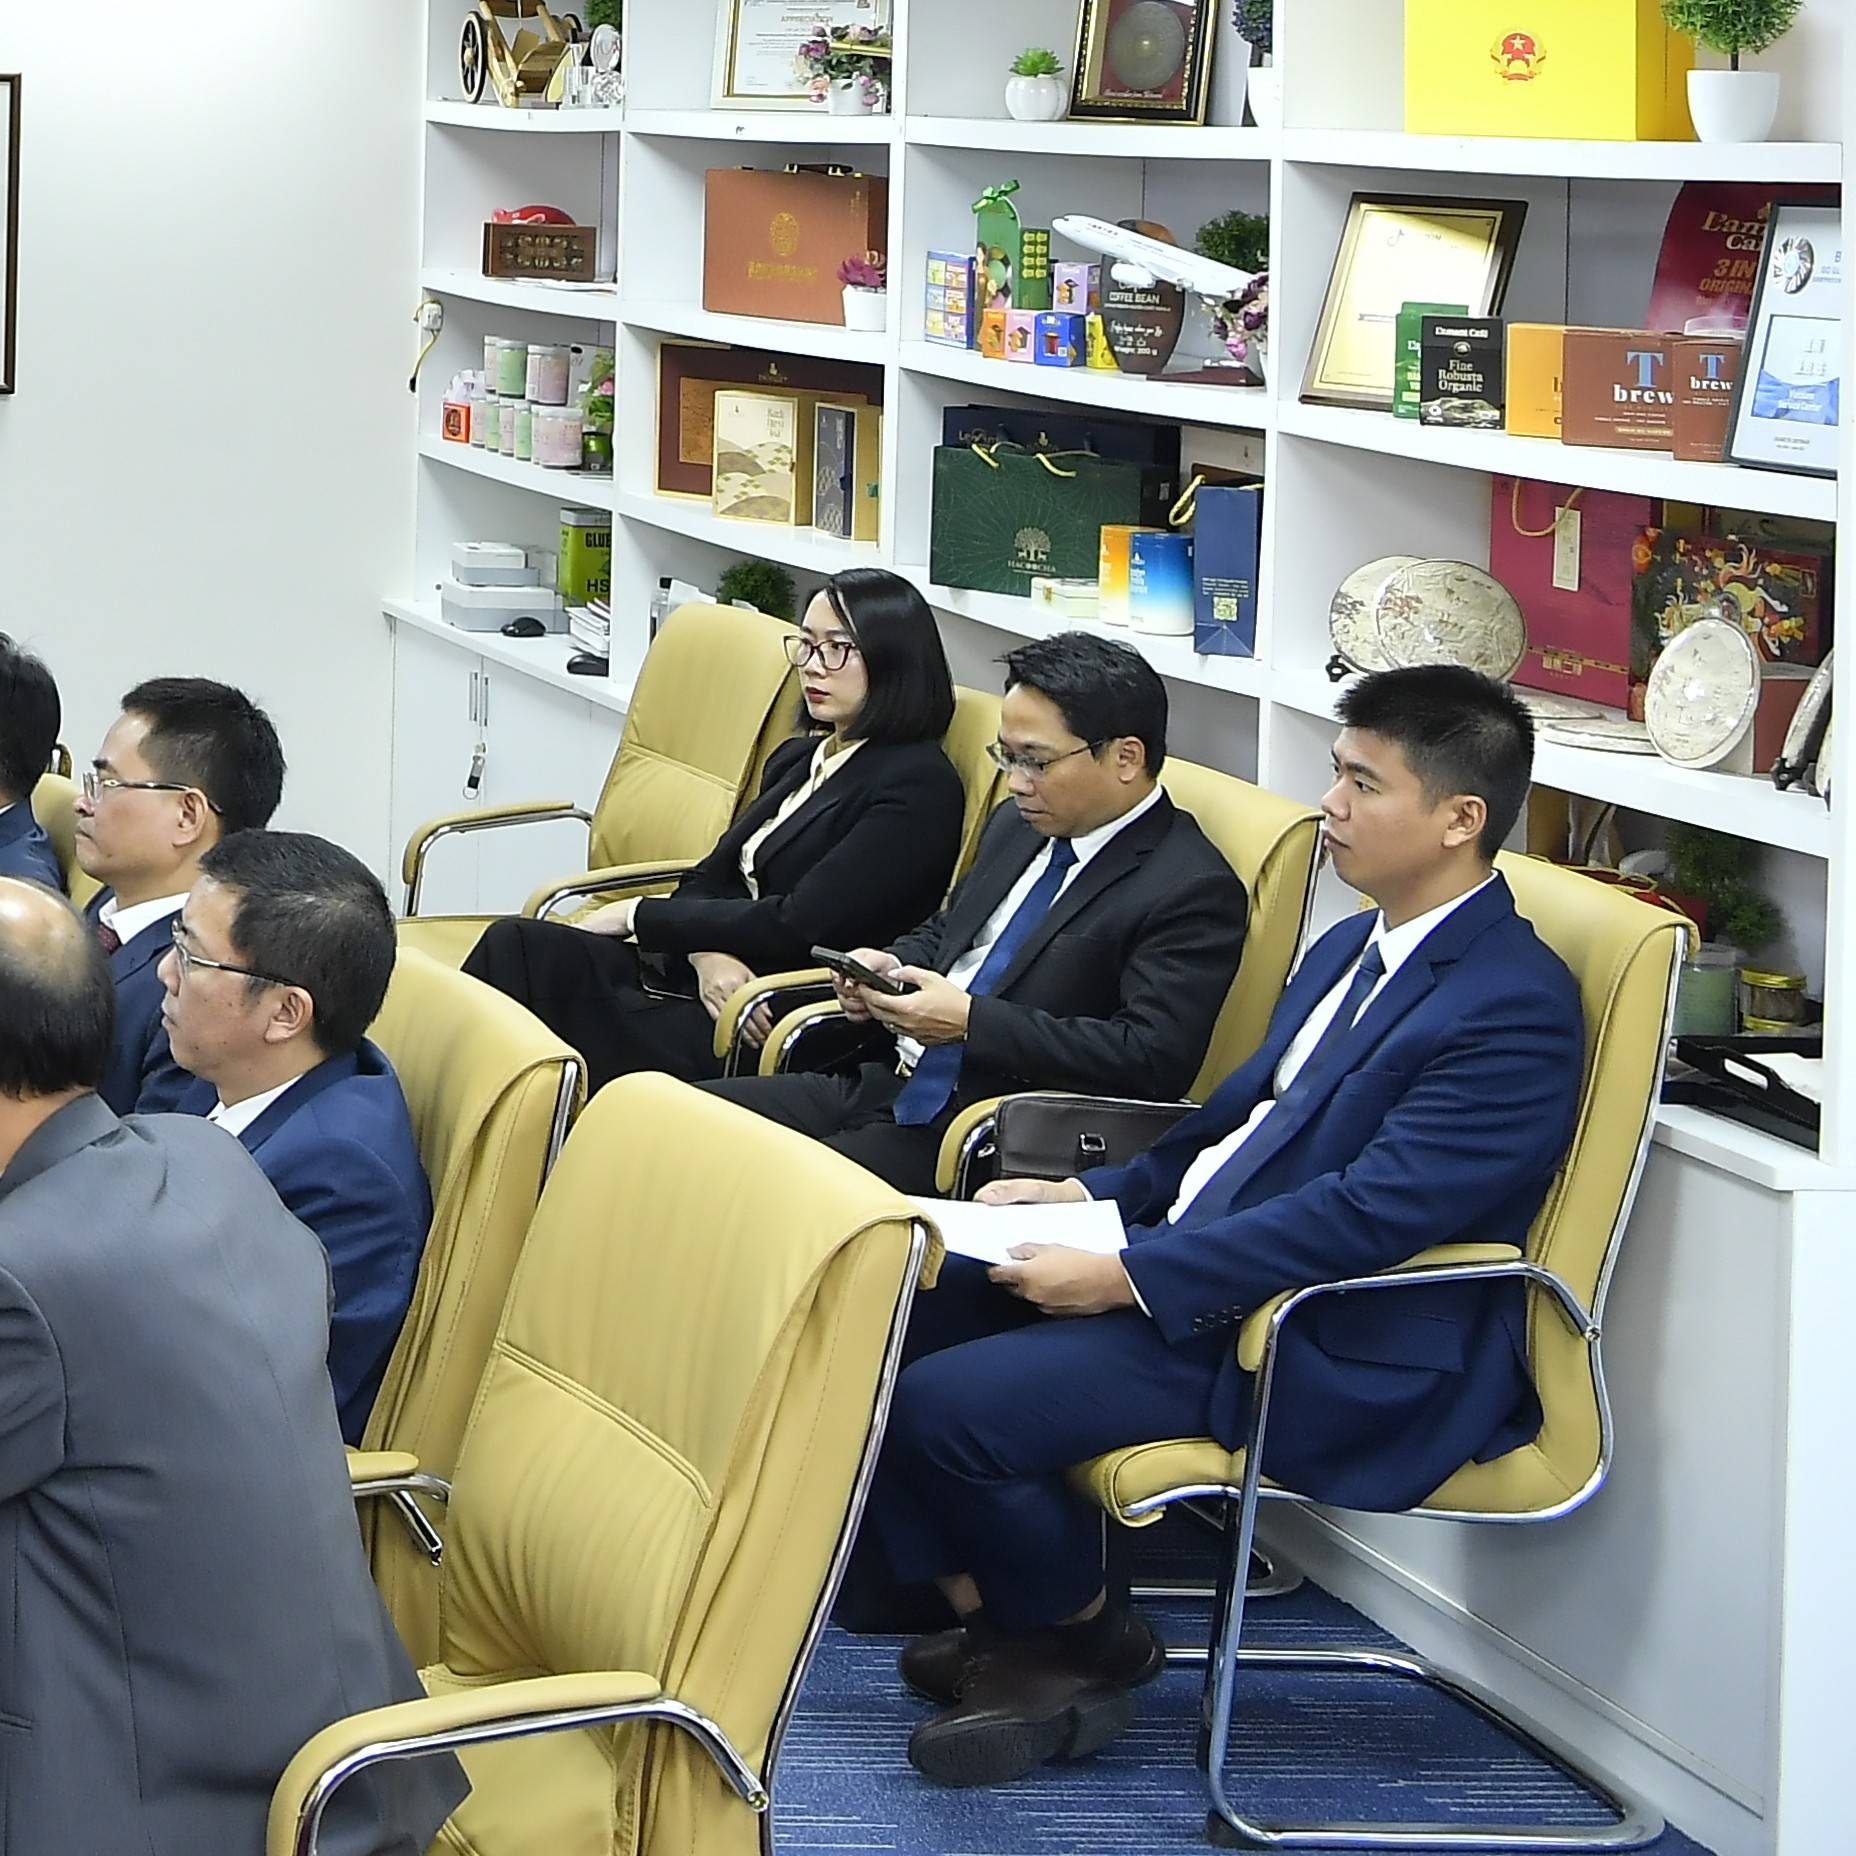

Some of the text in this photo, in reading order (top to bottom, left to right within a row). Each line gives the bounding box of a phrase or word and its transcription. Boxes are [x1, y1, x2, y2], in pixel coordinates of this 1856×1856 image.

[1135, 294, 1160, 304] BEAN
[1449, 359, 1473, 371] Fine
[1626, 351, 1664, 388] T
[1699, 354, 1725, 379] T
[1439, 369, 1484, 382] Robusta
[1438, 380, 1483, 393] Organic
[1690, 376, 1734, 390] brew
[1613, 384, 1674, 404] brew
